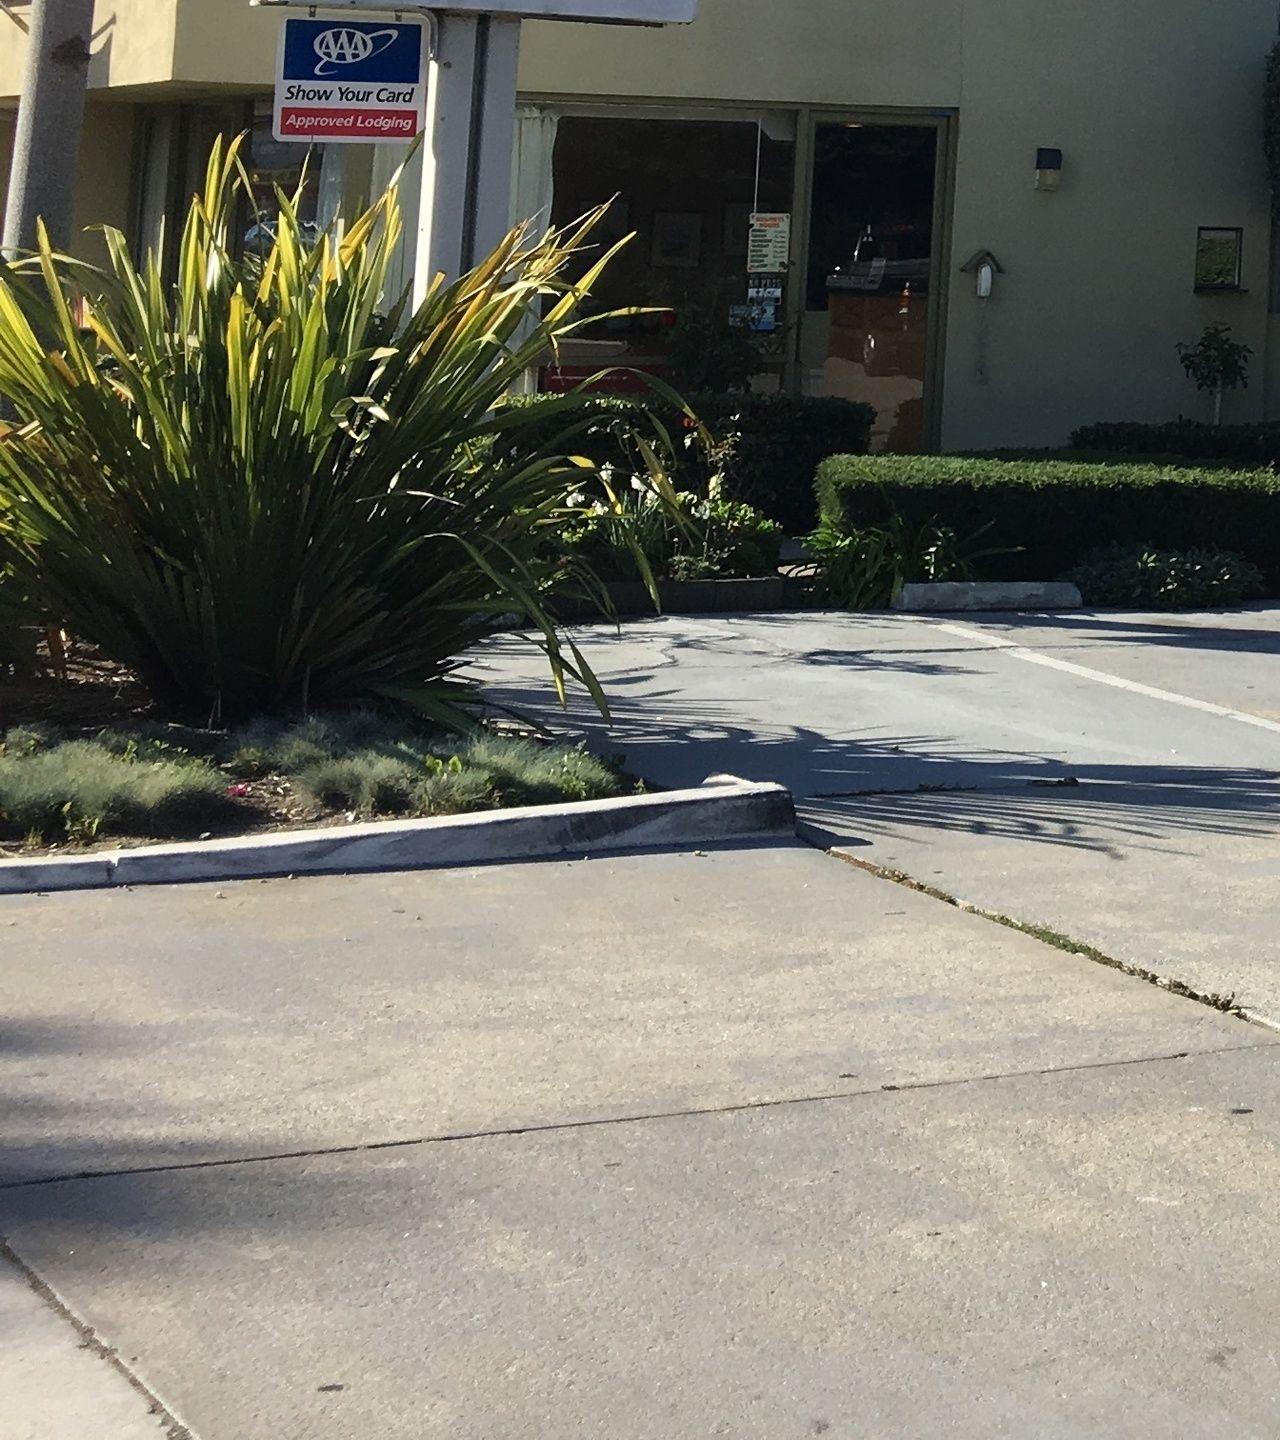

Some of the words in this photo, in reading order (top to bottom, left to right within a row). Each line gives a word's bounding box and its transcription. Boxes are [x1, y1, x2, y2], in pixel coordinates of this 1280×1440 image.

[319, 29, 369, 62] AAA
[285, 85, 333, 101] Show
[338, 86, 374, 103] Your
[376, 87, 415, 103] Card
[285, 114, 353, 128] Approved
[356, 116, 413, 131] Lodging
